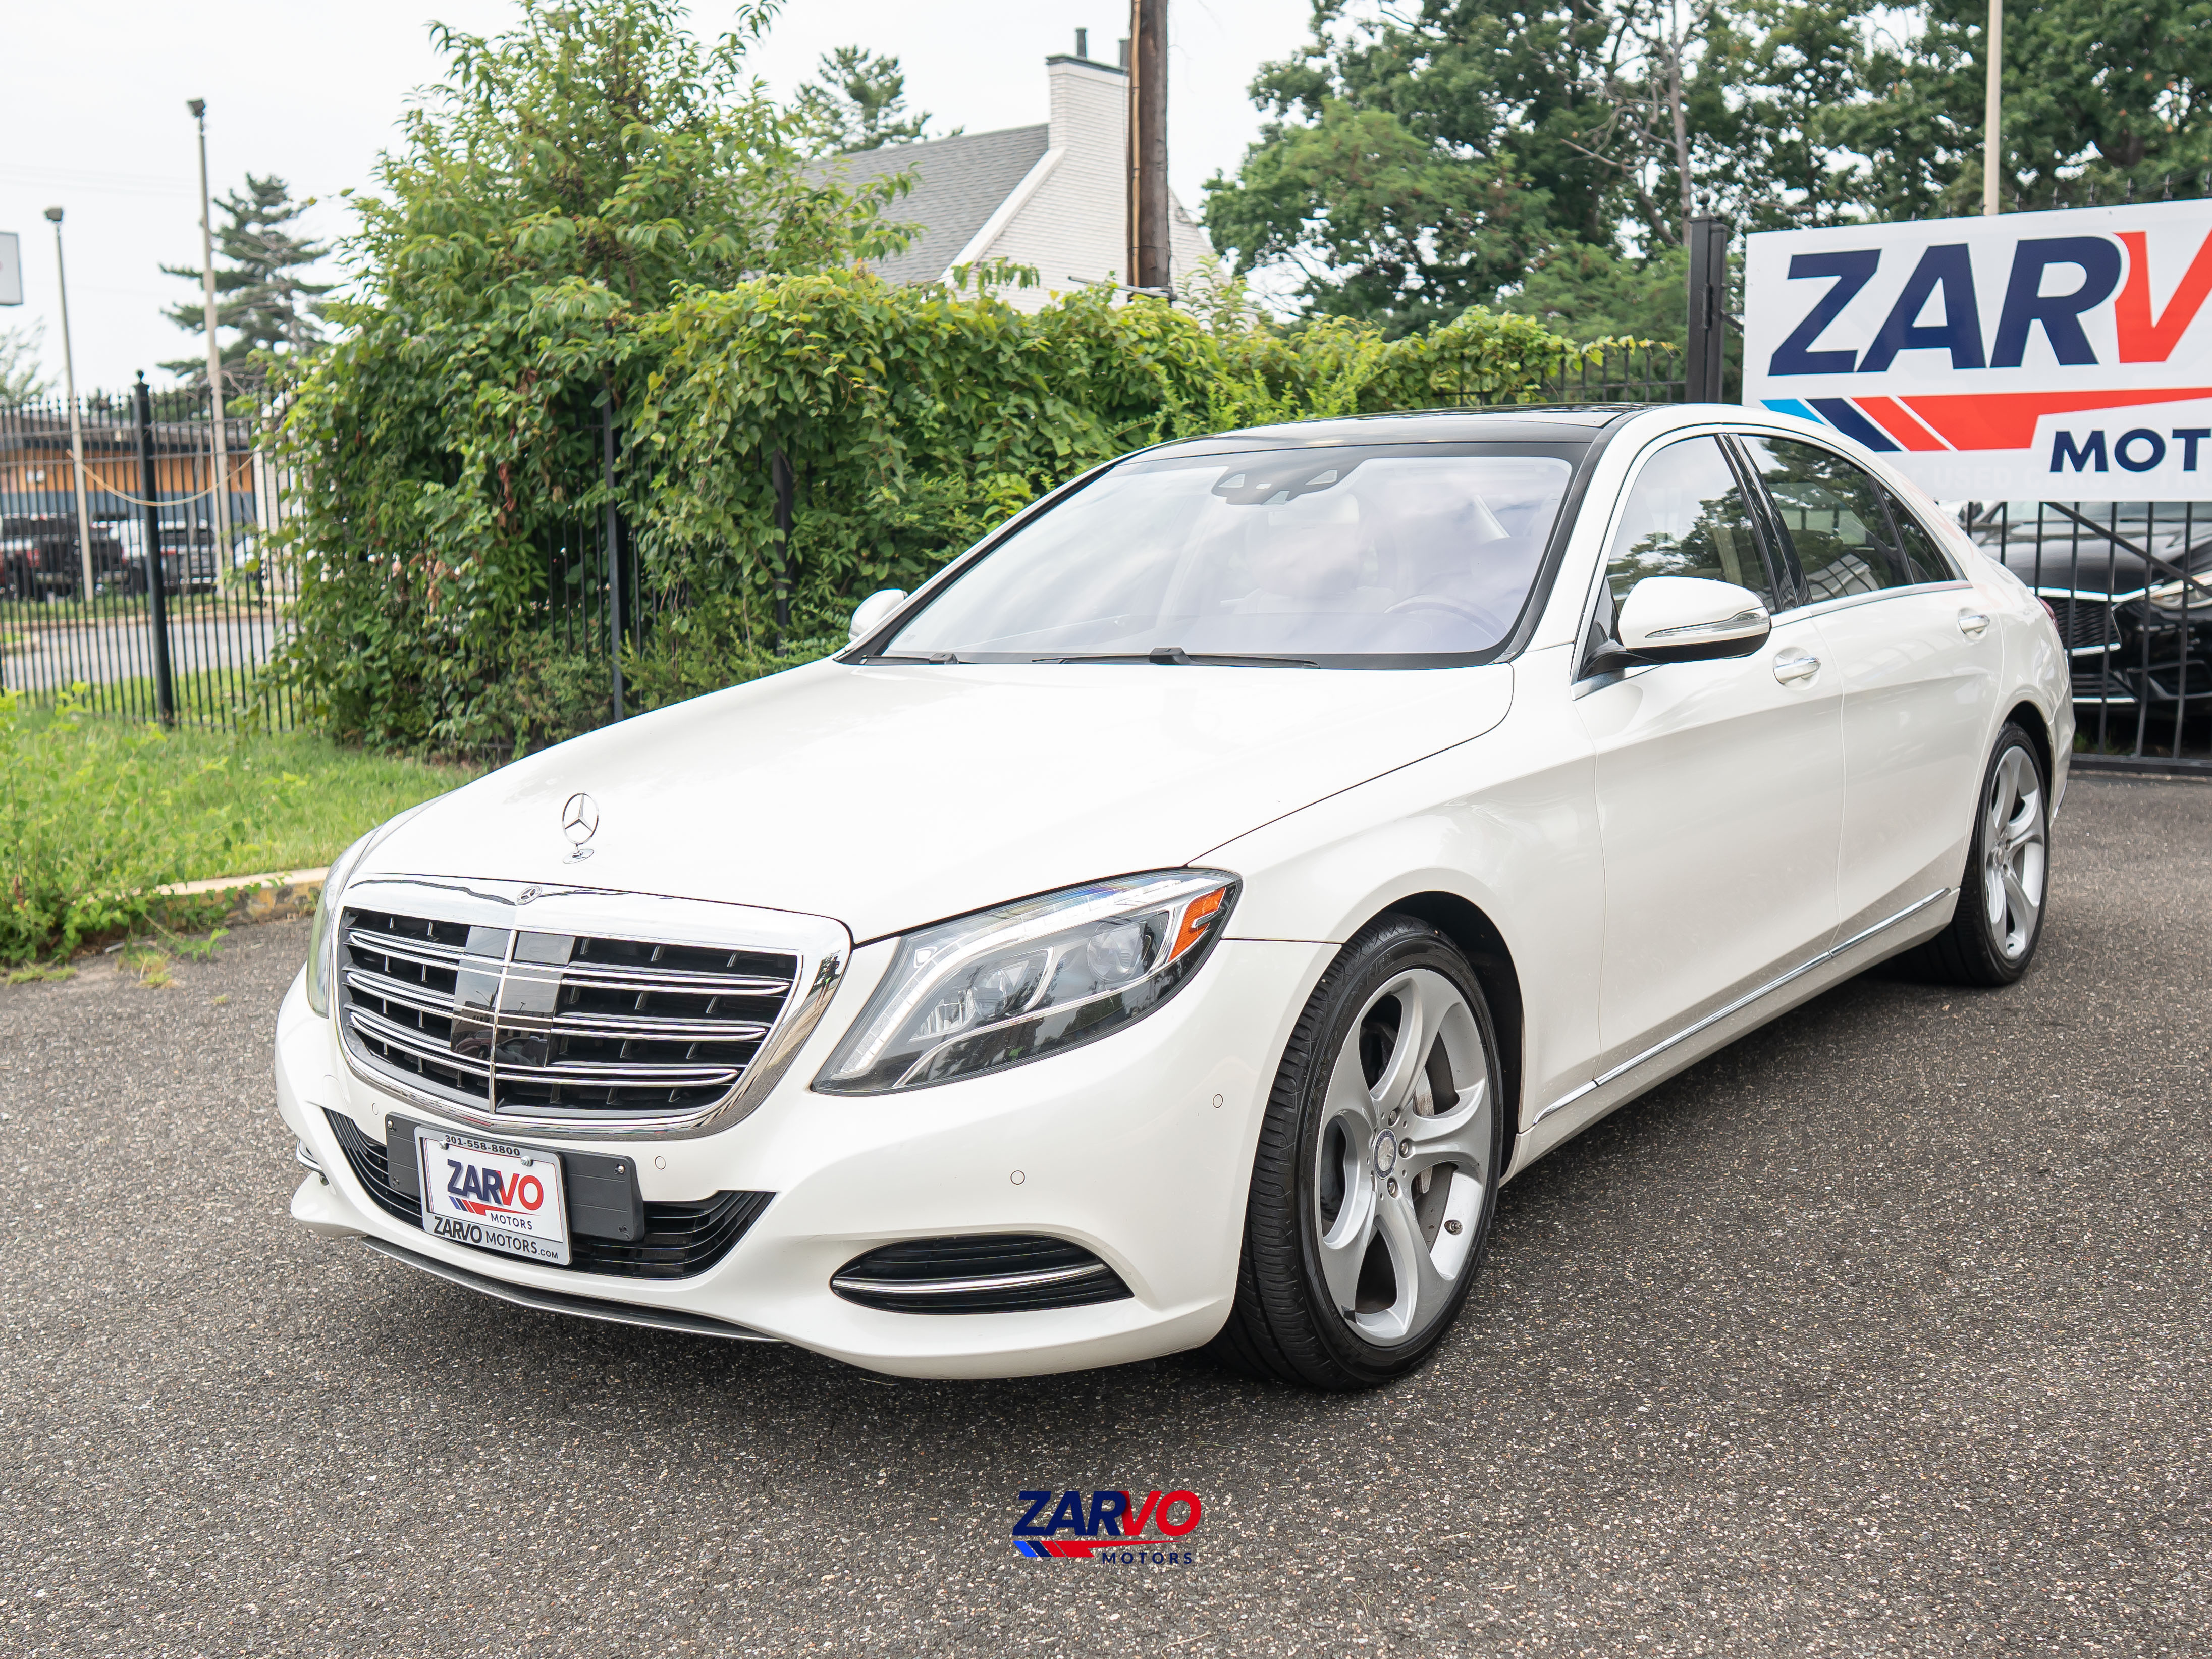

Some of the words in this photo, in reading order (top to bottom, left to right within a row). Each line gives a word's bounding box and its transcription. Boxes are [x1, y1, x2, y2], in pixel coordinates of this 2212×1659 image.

[1934, 466, 2012, 489] USED
[445, 1135, 520, 1156] 301-558-8800
[447, 1159, 544, 1211] ZARVO
[434, 1216, 482, 1243] ZARVO
[491, 1213, 532, 1230] MOTORS
